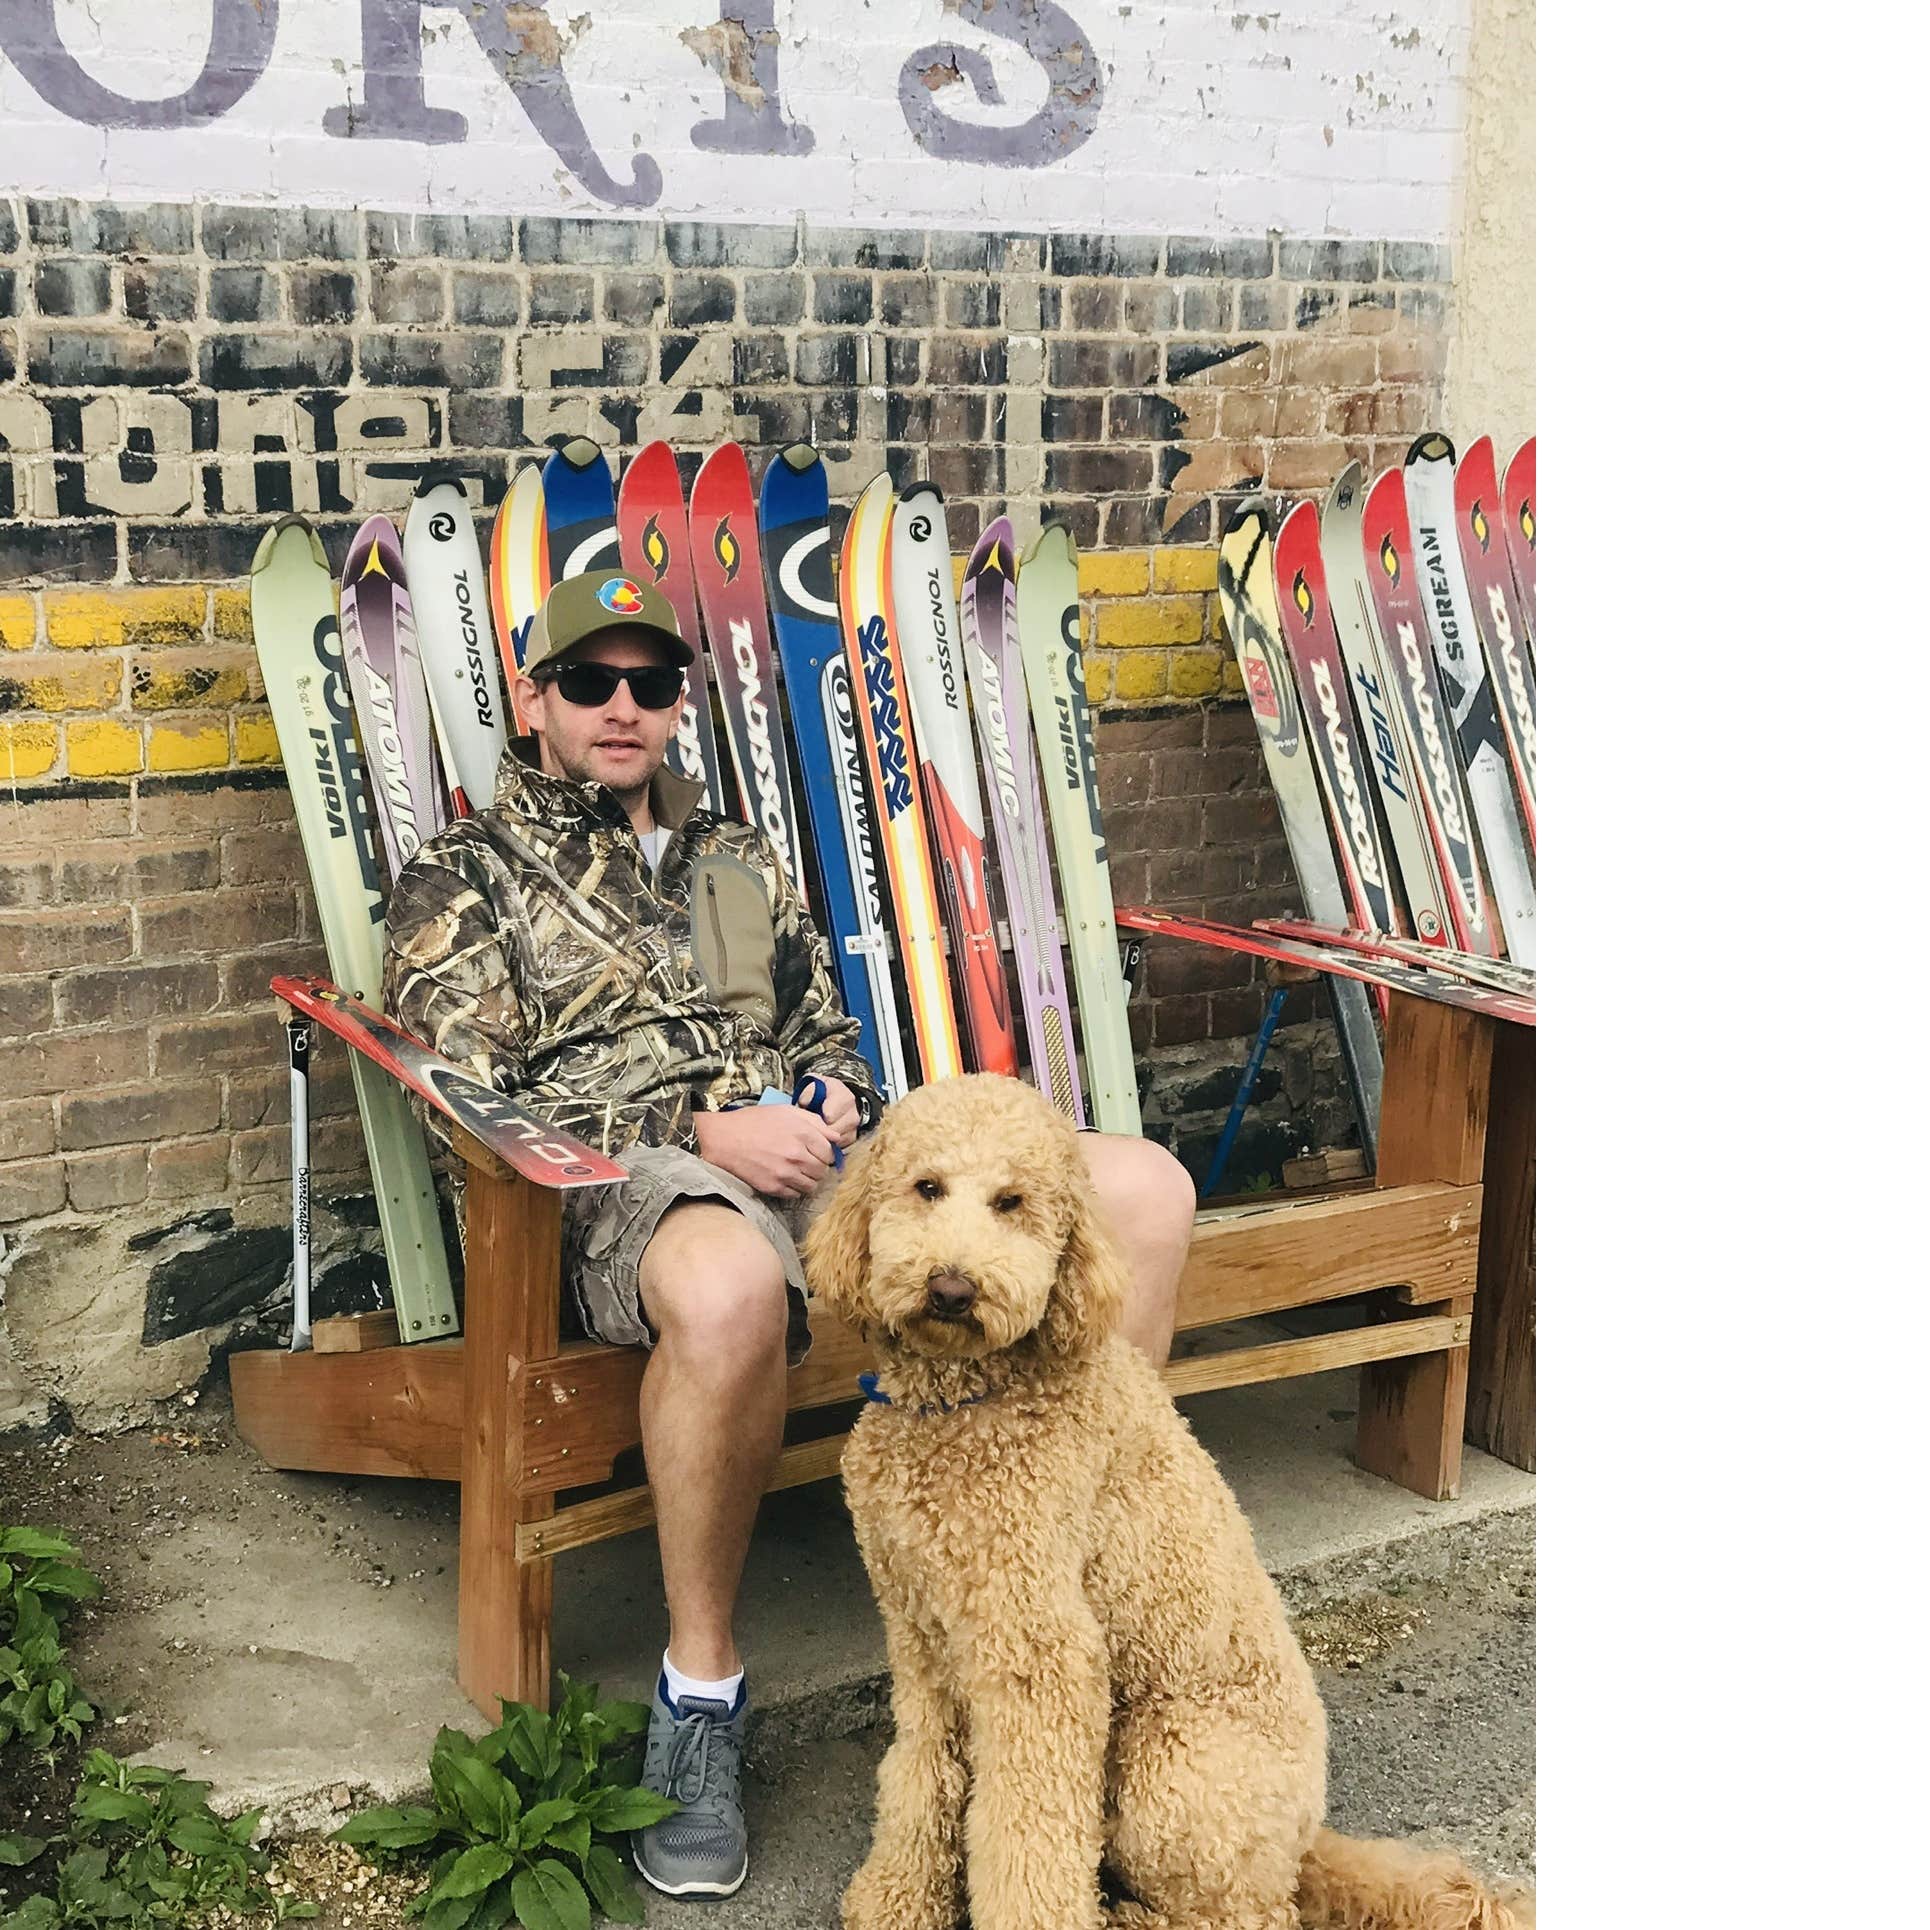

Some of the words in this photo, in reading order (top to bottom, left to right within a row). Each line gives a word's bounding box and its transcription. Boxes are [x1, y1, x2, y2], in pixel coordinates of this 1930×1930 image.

[459, 568, 494, 728] ROSSIGNOL
[928, 567, 959, 709] ROSSIGNOL
[1419, 527, 1464, 662] SCREAM
[308, 728, 347, 839] Völkl
[363, 666, 418, 858] ATOMIC
[729, 616, 793, 877] ROSSIGNOL
[977, 650, 1021, 817] ATOMIC
[1051, 695, 1080, 789] Völkl
[1310, 656, 1382, 888] ROSSIGNOL
[1356, 662, 1408, 802] Hart
[1397, 620, 1466, 845] ROSSIGNOL
[845, 746, 881, 925] SALOMON
[462, 1098, 580, 1165] CUT
